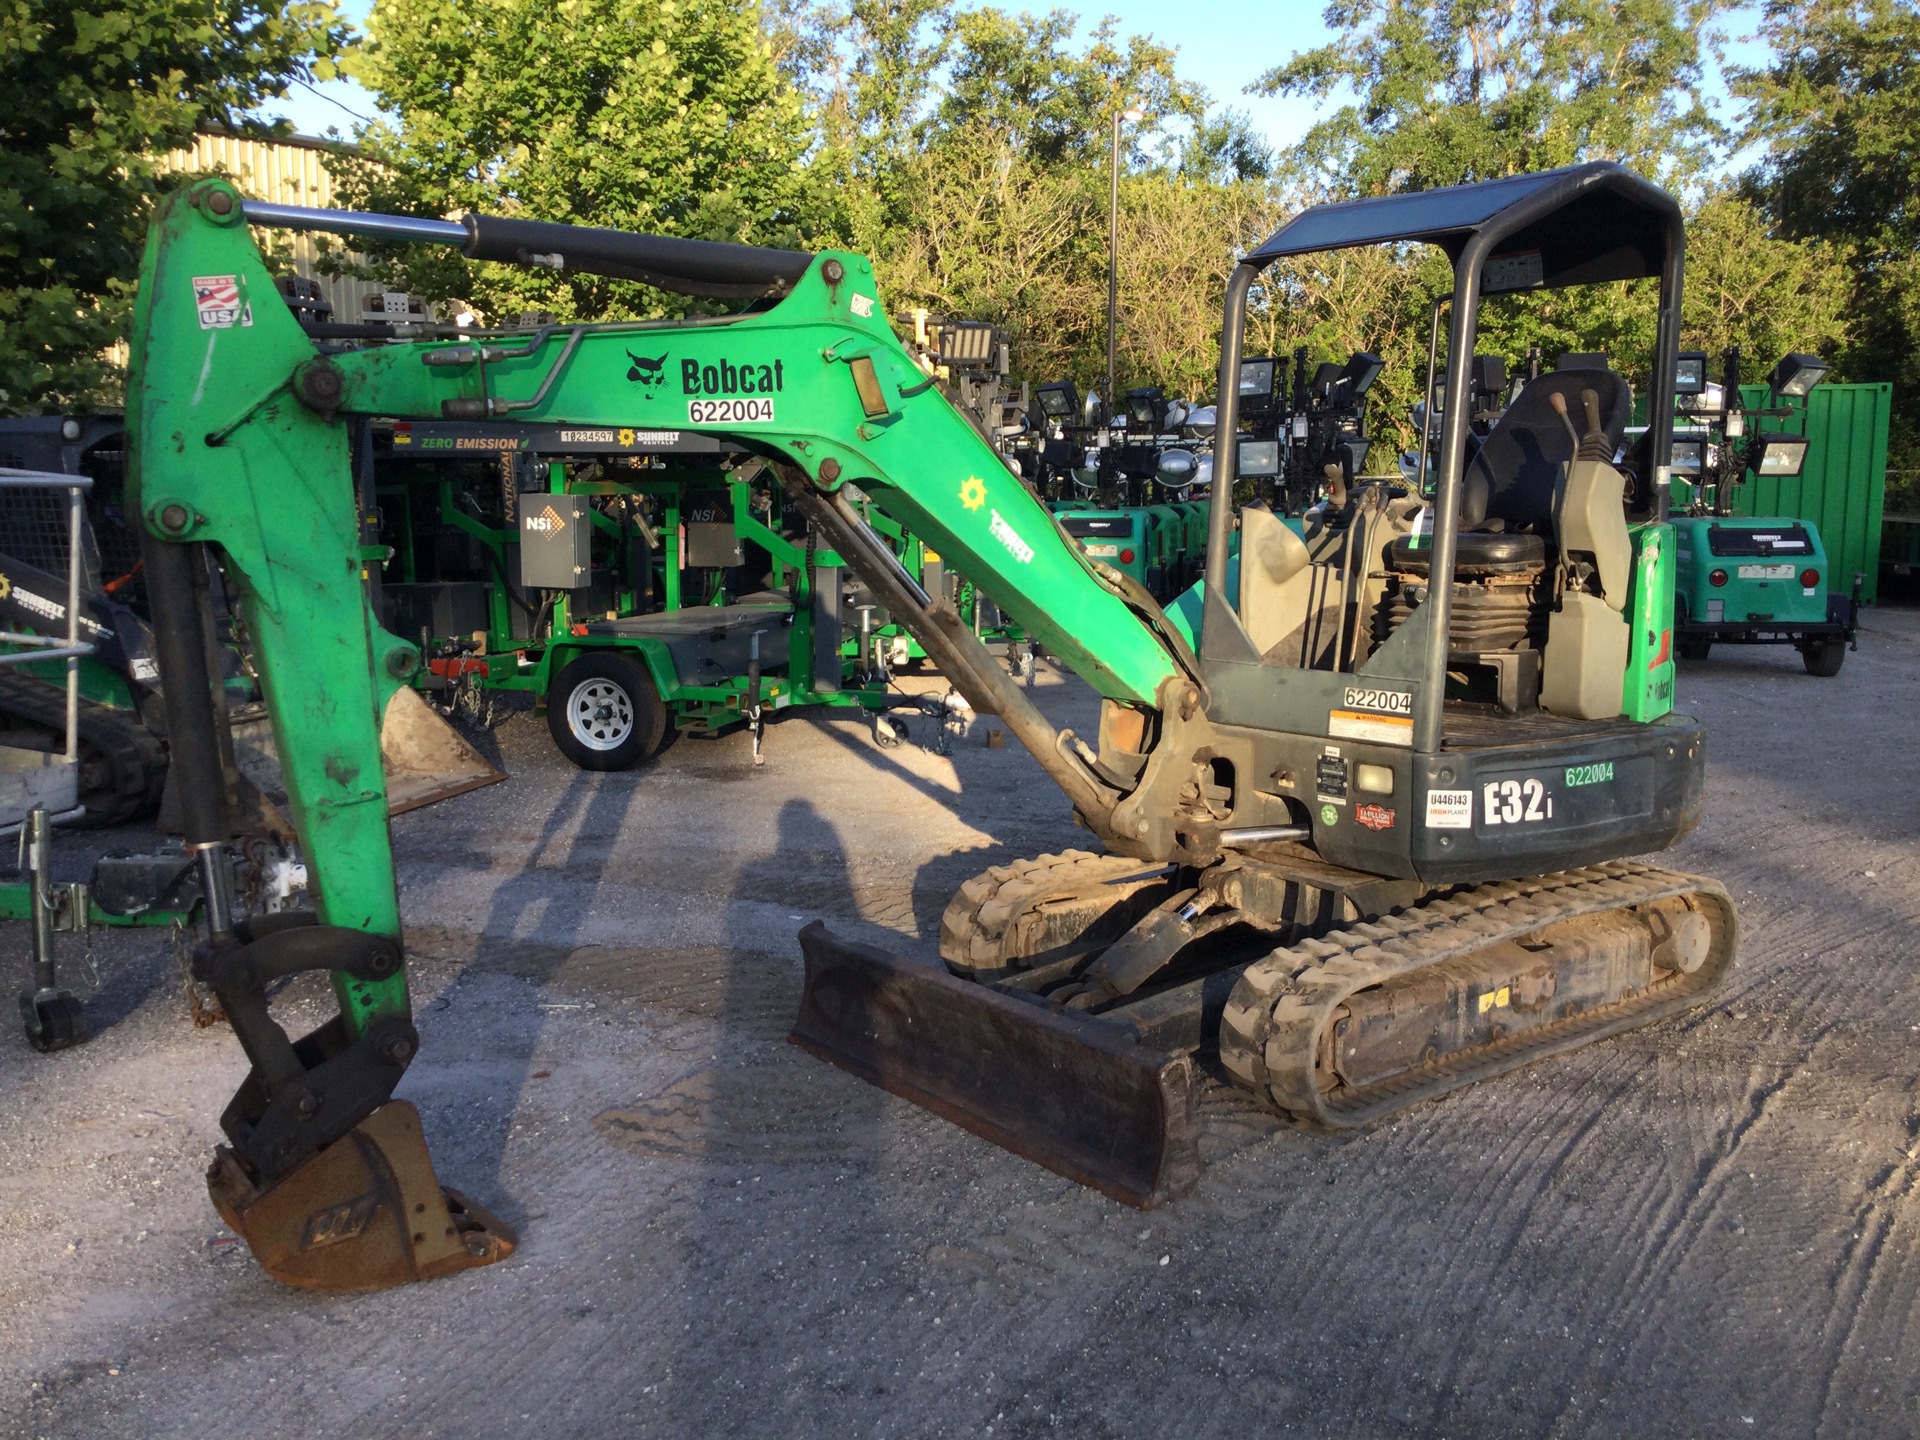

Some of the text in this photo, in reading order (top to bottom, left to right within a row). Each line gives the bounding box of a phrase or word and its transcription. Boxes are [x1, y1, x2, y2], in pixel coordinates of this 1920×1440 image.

[681, 358, 784, 394] Bobcat
[690, 400, 773, 422] 622004
[421, 438, 453, 449] ZERO
[456, 438, 518, 449] EMISSION
[564, 431, 612, 441] 10234597
[637, 432, 680, 441] SUNBELT
[12, 586, 66, 619] SUNBELT
[1345, 688, 1410, 712] 622004
[1362, 715, 1387, 723] WARNING
[1565, 762, 1614, 787] 622004
[1431, 794, 1467, 805] U446143
